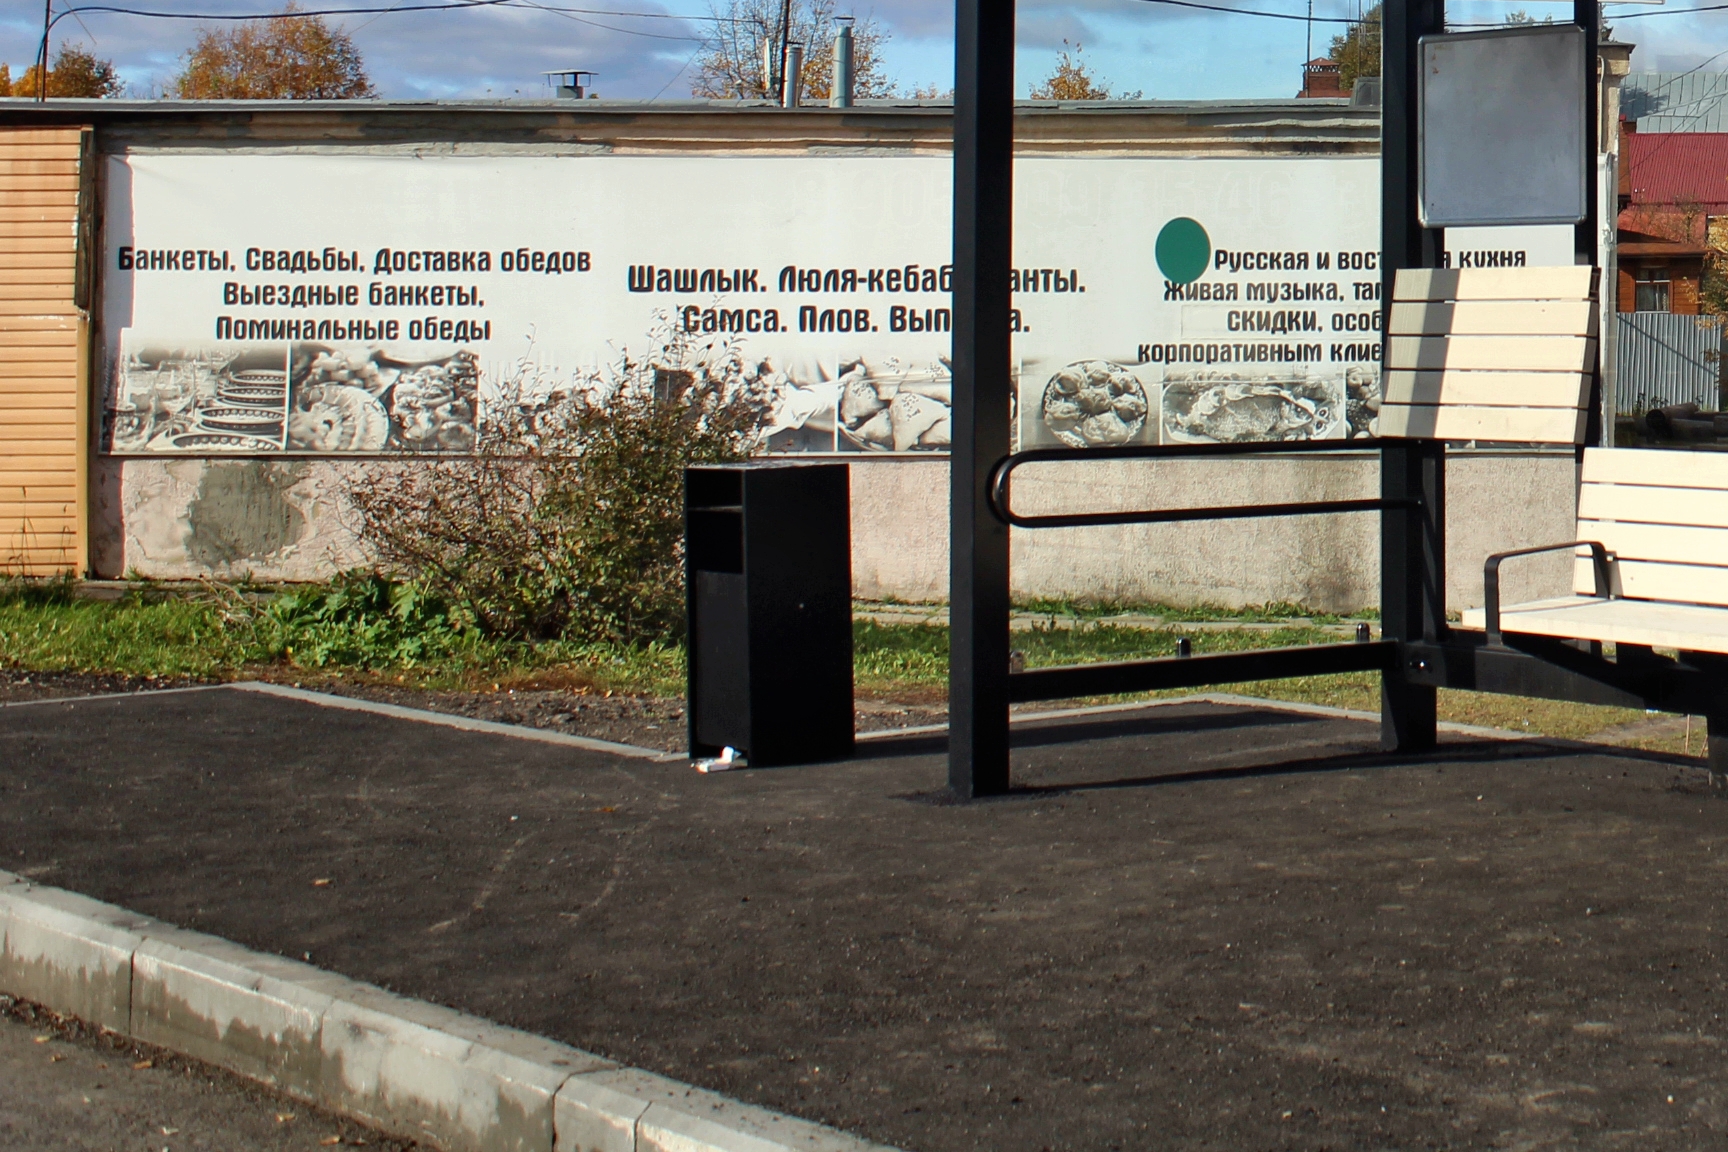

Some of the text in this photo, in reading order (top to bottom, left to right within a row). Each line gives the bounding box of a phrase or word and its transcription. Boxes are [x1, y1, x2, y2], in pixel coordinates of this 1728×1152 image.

[118, 246, 590, 274] Банкеты, Свадьбы, Доставка обедов
[1215, 250, 1308, 272] Русская
[1317, 252, 1329, 269] и
[628, 266, 766, 292] Шашлык.
[1163, 280, 1239, 302] Живая
[1247, 283, 1344, 303] музыка,
[224, 282, 483, 308] Выездные банкеты,
[217, 317, 490, 342] Поминальные обеды
[683, 305, 788, 333] Самса.
[799, 306, 877, 332] Плов.
[1137, 344, 1323, 364] корпоративным
